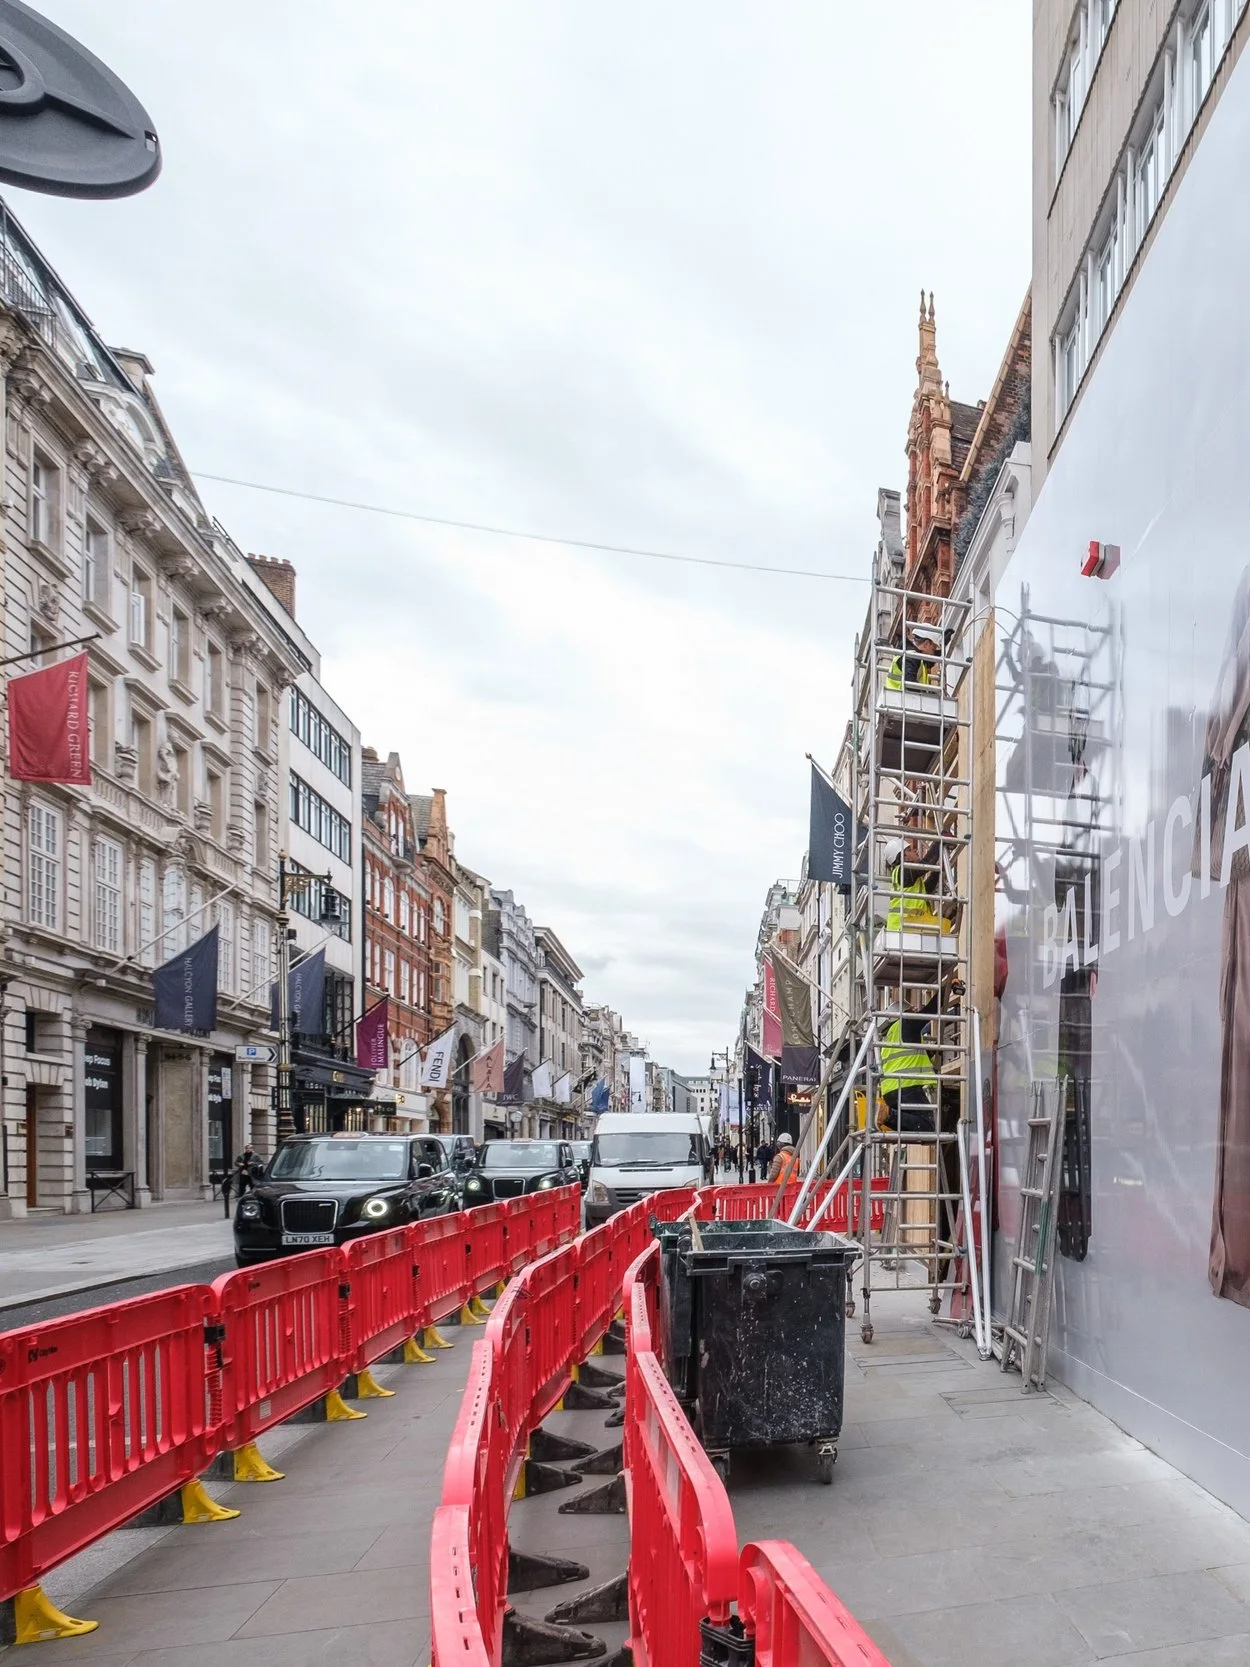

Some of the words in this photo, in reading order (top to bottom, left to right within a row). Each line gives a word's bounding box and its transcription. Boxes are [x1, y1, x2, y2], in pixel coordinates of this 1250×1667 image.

[66, 671, 80, 730] RICHARD
[67, 733, 82, 778] GREEN
[833, 812, 845, 848] CHOO
[832, 849, 844, 879] JIMMY
[184, 957, 193, 993] HALCYON
[184, 994, 193, 1028] GALLERY
[377, 1024, 385, 1063] MALINGUE
[429, 1051, 445, 1082] FENDI
[782, 1074, 817, 1082] PANERAI
[285, 1236, 310, 1244] LN70
[311, 1235, 330, 1243] XEH
